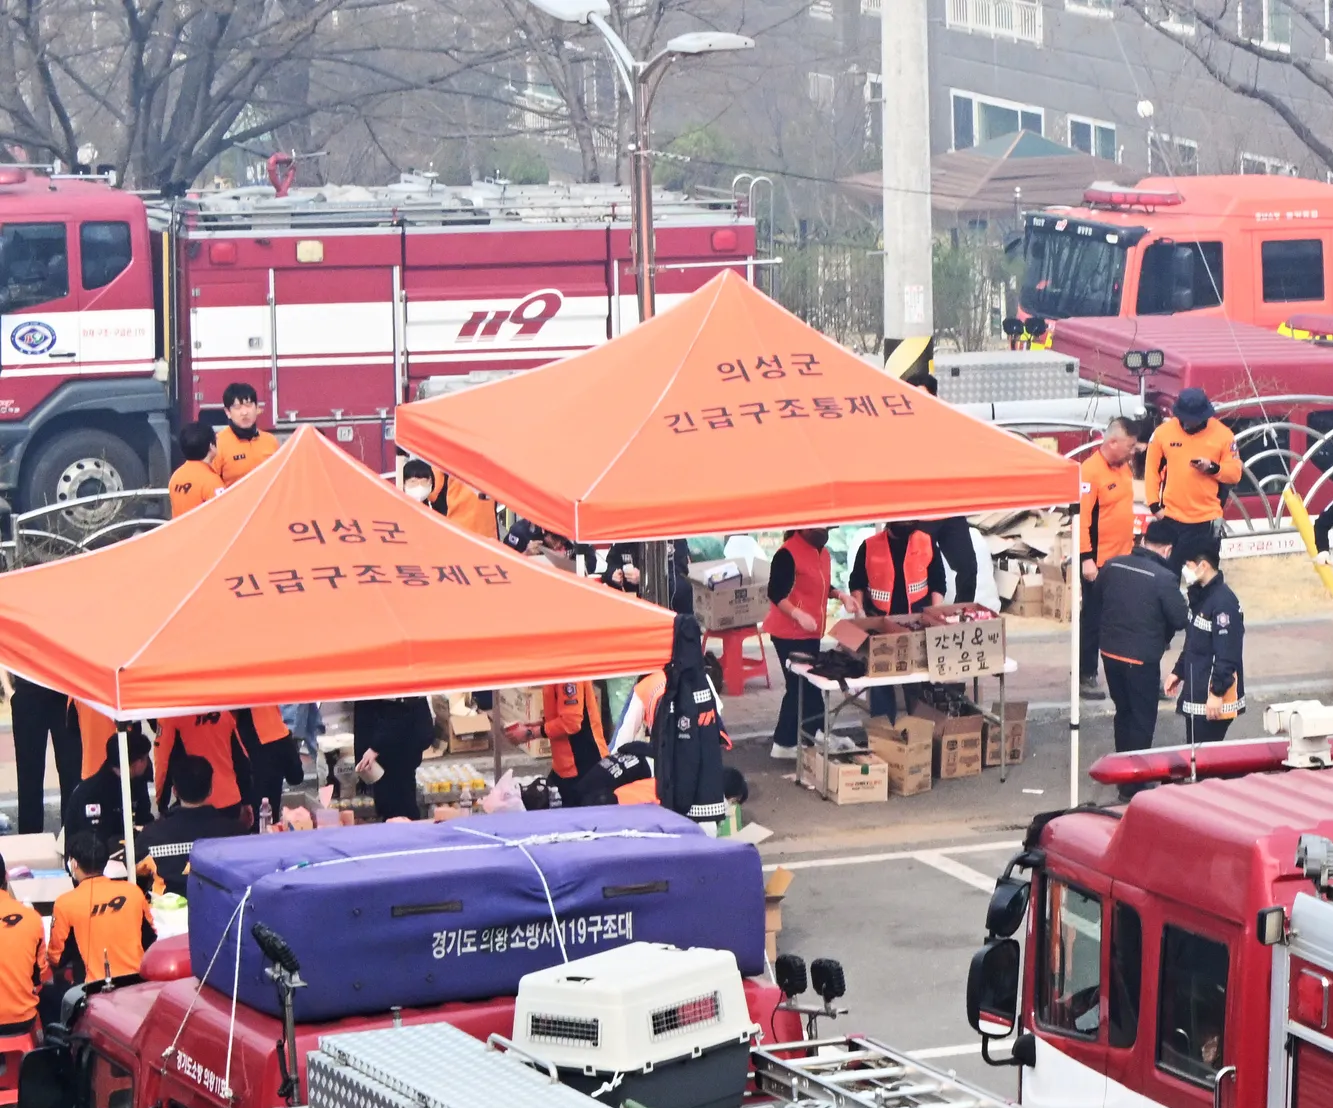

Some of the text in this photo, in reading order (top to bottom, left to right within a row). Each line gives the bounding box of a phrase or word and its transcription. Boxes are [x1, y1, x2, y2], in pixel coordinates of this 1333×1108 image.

[454, 292, 562, 343] 119
[717, 352, 823, 383] 의성군
[663, 394, 915, 434] 긴급구조통제단
[174, 482, 192, 494] 119
[288, 518, 408, 544] 의성군
[224, 564, 512, 599] 긴급구조통제단
[934, 630, 965, 649] 간식
[971, 627, 984, 645] &
[91, 896, 127, 917] 119
[431, 928, 478, 959] 경기도
[480, 925, 509, 953] 의왕
